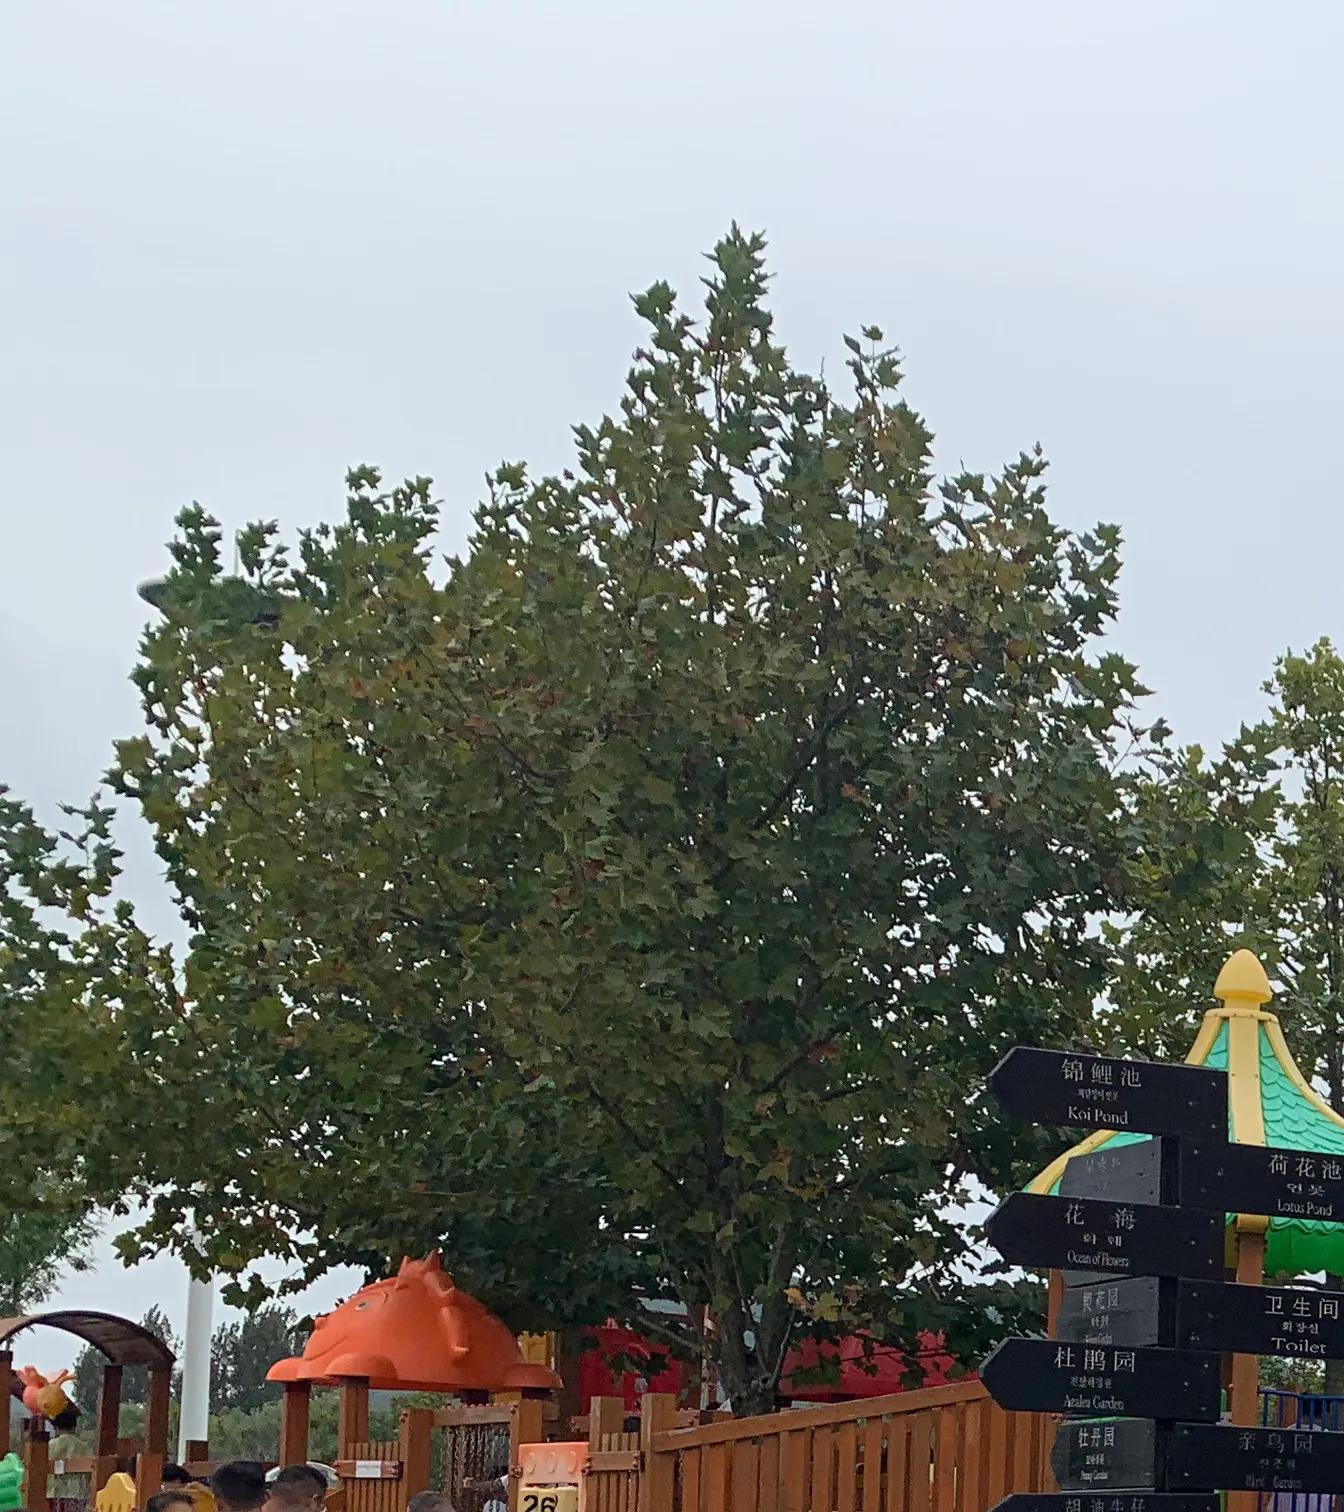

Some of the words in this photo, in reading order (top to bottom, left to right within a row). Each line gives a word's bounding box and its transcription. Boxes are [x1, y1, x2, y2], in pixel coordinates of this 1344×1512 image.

[1062, 1059, 1142, 1087] 锦鲤池
[1068, 1106, 1091, 1120] Koi
[1095, 1109, 1128, 1124] Pond
[1268, 1154, 1342, 1180] 荷花池
[1278, 1199, 1305, 1214] Lotus
[1306, 1201, 1333, 1216] Pond
[1067, 1250, 1091, 1264] Ocean
[1092, 1251, 1102, 1265] of
[1102, 1252, 1129, 1267] Flowers
[1265, 1295, 1338, 1320] 卫生间
[1271, 1338, 1327, 1354] Toilet
[1054, 1347, 1136, 1372] 杜鹃园
[1092, 1395, 1124, 1410] Garden
